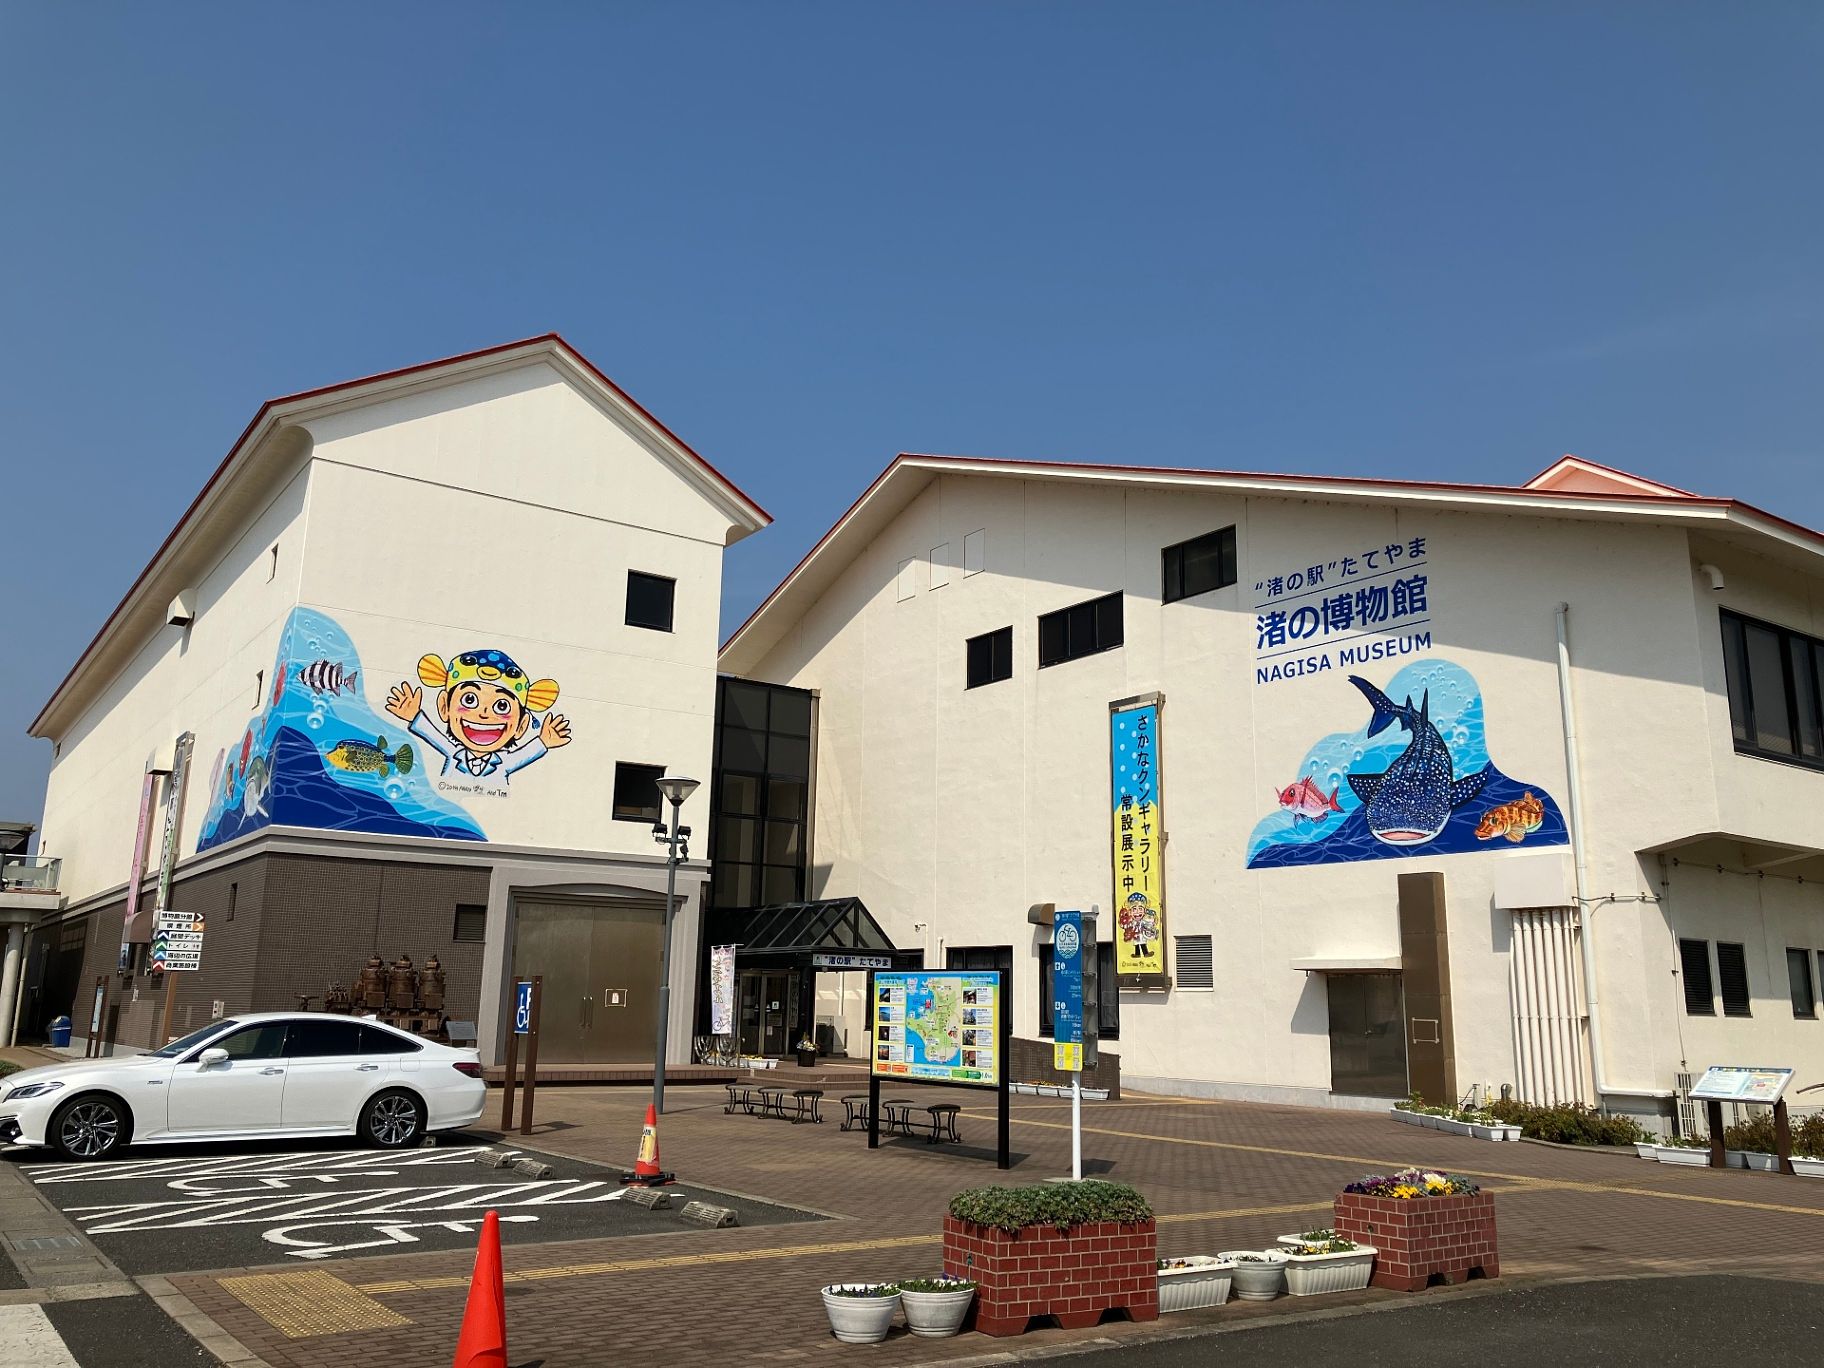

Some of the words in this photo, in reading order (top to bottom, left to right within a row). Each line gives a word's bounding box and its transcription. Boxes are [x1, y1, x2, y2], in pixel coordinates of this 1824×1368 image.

[1256, 574, 1429, 650] 渚の博物館
[1257, 654, 1331, 684] NAGISA
[1340, 632, 1432, 667] MUSEUM
[1120, 793, 1134, 893] 常設展示中
[860, 958, 889, 967] たてやま
